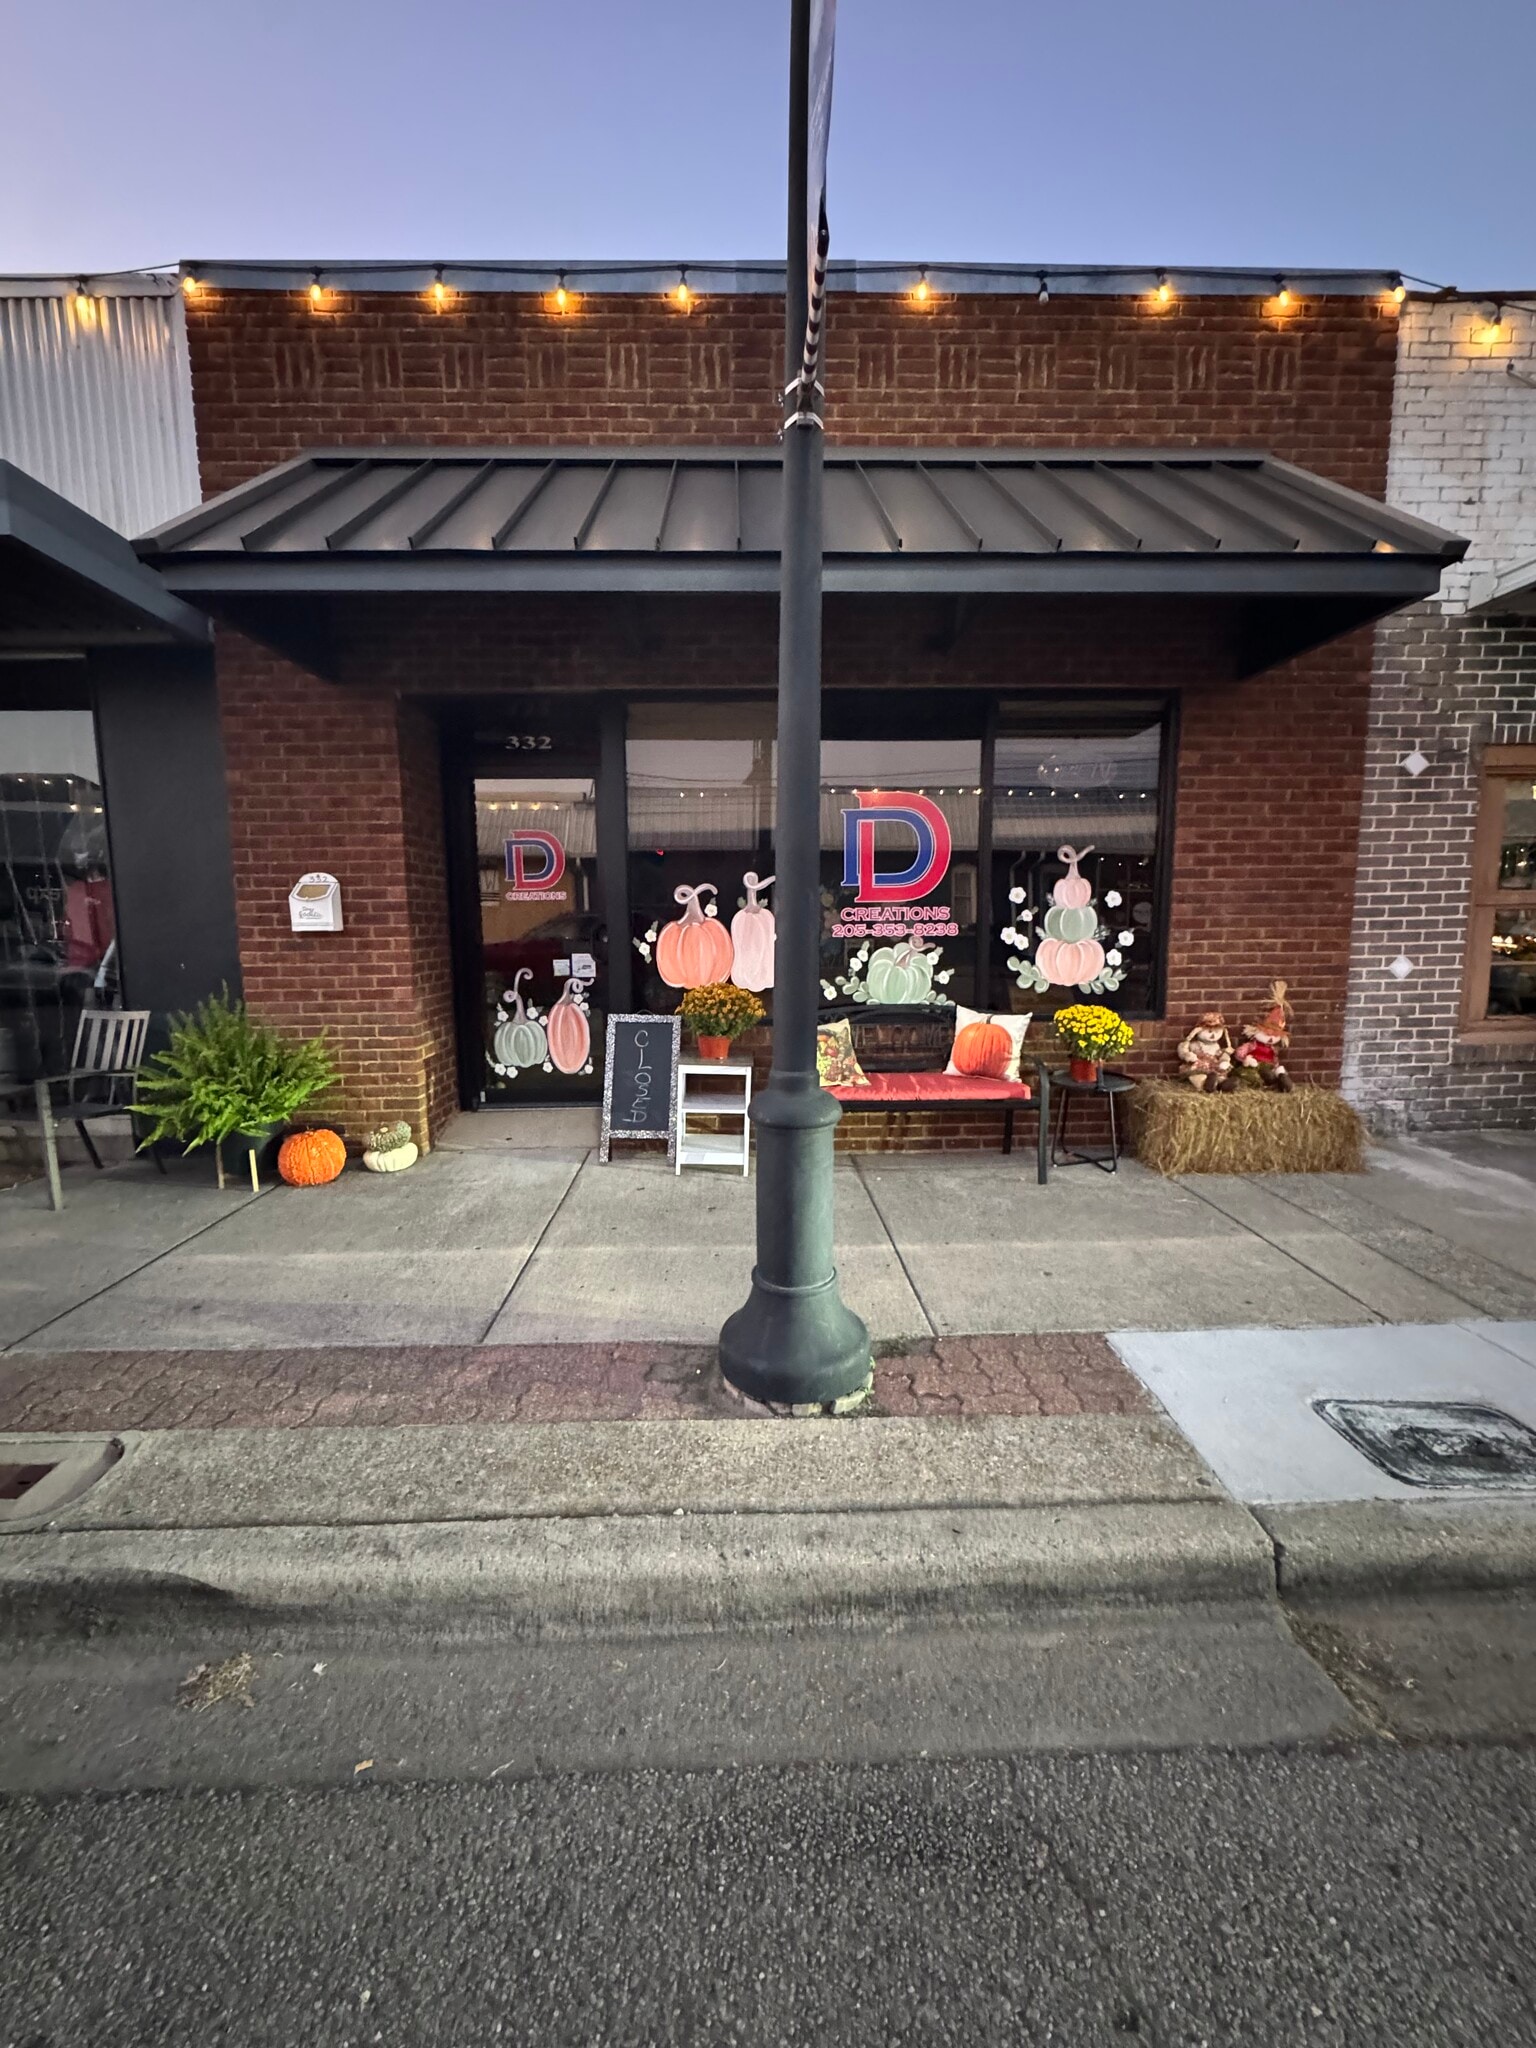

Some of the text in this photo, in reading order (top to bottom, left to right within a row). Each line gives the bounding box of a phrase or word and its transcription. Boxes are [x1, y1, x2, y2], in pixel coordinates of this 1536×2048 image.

[505, 735, 552, 750] 332
[309, 875, 330, 883] 332
[505, 891, 567, 901] CREATIONS
[840, 906, 951, 921] CREATIONS
[831, 922, 959, 938] 205-353-8238
[622, 1029, 653, 1123] CLOSED
